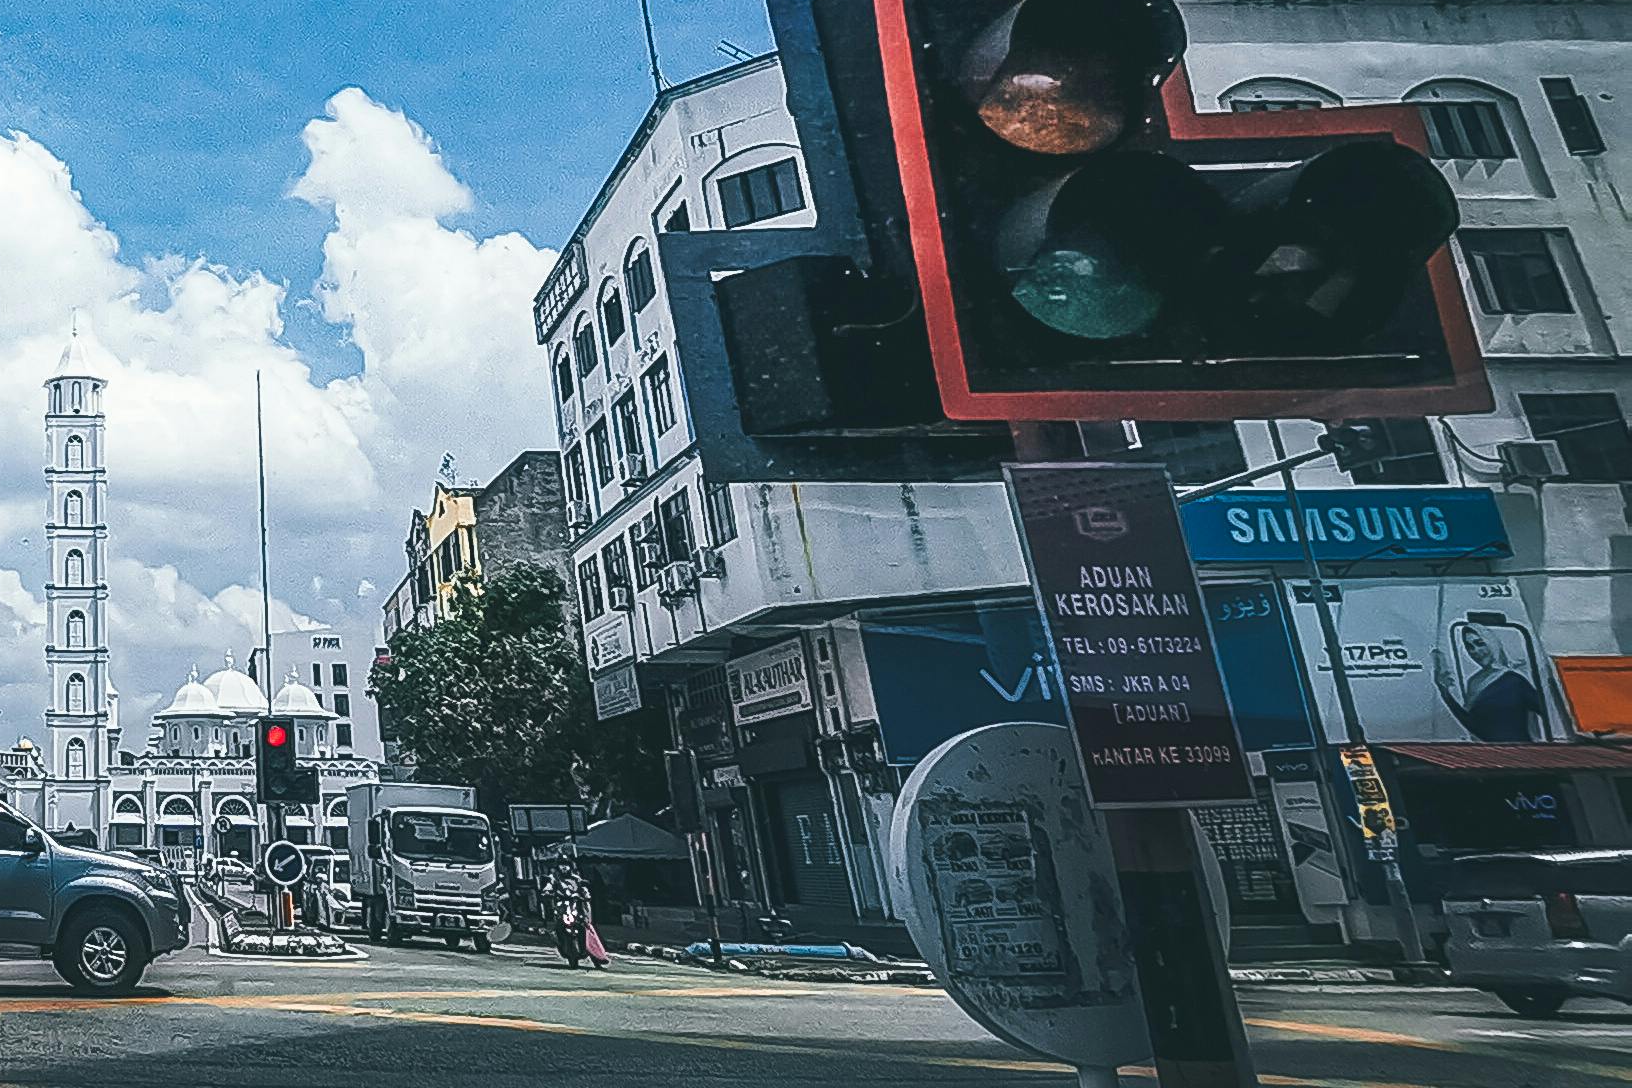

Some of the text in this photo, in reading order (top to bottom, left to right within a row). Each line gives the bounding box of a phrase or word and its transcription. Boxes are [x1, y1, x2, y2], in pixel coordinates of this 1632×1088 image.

[1226, 506, 1450, 544] SAMSUNG
[1080, 565, 1153, 588] ADUAN
[1055, 593, 1190, 616] KEROSAKAN
[1121, 675, 1154, 692] JKR
[1158, 675, 1169, 691] A
[1171, 675, 1191, 691] 04
[1113, 703, 1191, 725] [ADUAN]
[1091, 745, 1231, 766] HANTAR KE 33099
[1504, 791, 1557, 810] vivo
